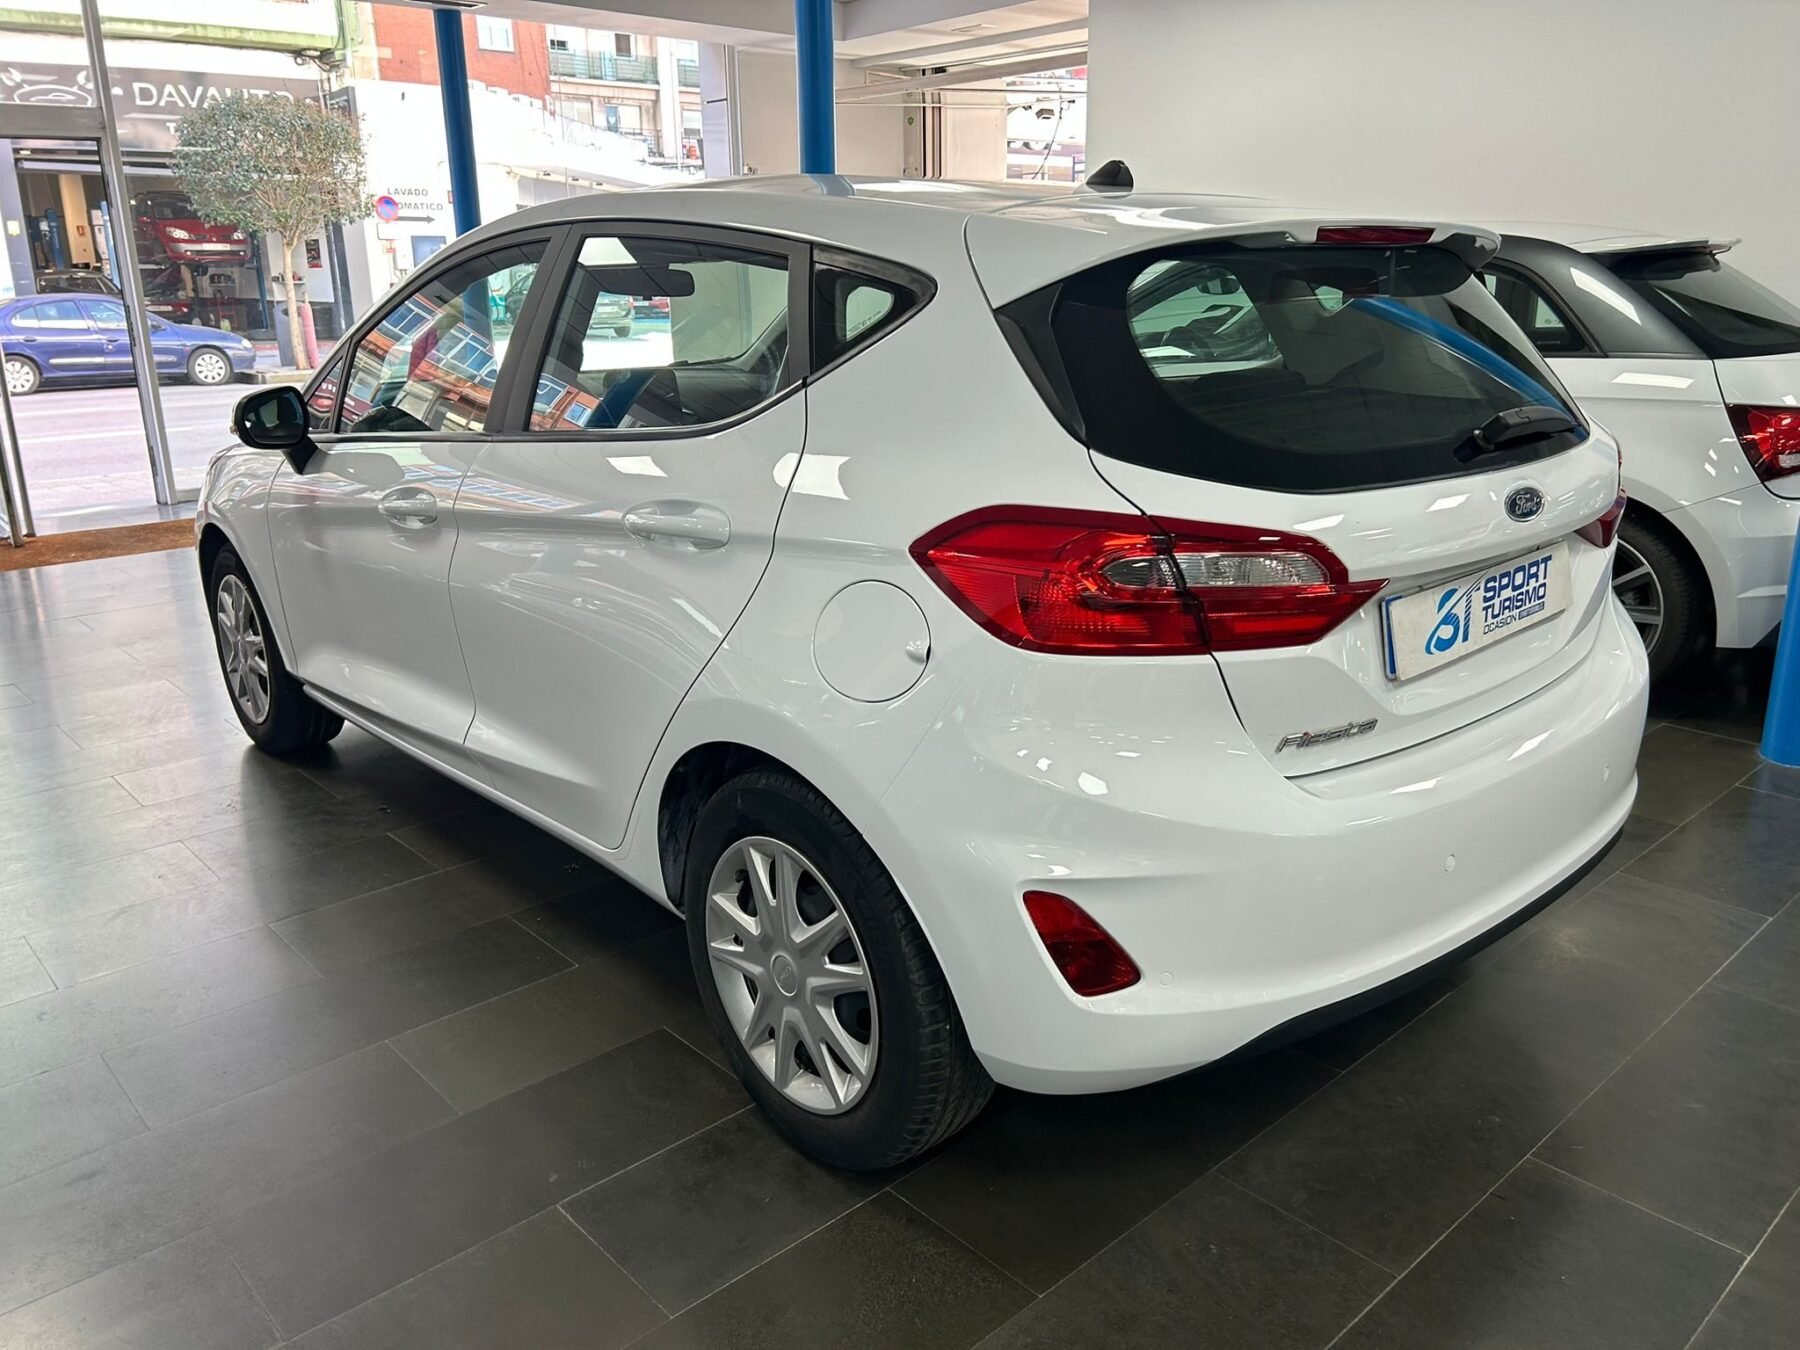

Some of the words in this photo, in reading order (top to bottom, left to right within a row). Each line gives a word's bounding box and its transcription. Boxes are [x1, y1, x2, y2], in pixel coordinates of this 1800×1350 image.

[387, 187, 429, 197] LAVADO
[1515, 493, 1539, 514] Ford
[1483, 554, 1552, 604] SPORT
[1482, 582, 1547, 623] TURISMO
[1483, 611, 1517, 635] OCASION
[1275, 718, 1378, 754] Fiesta
